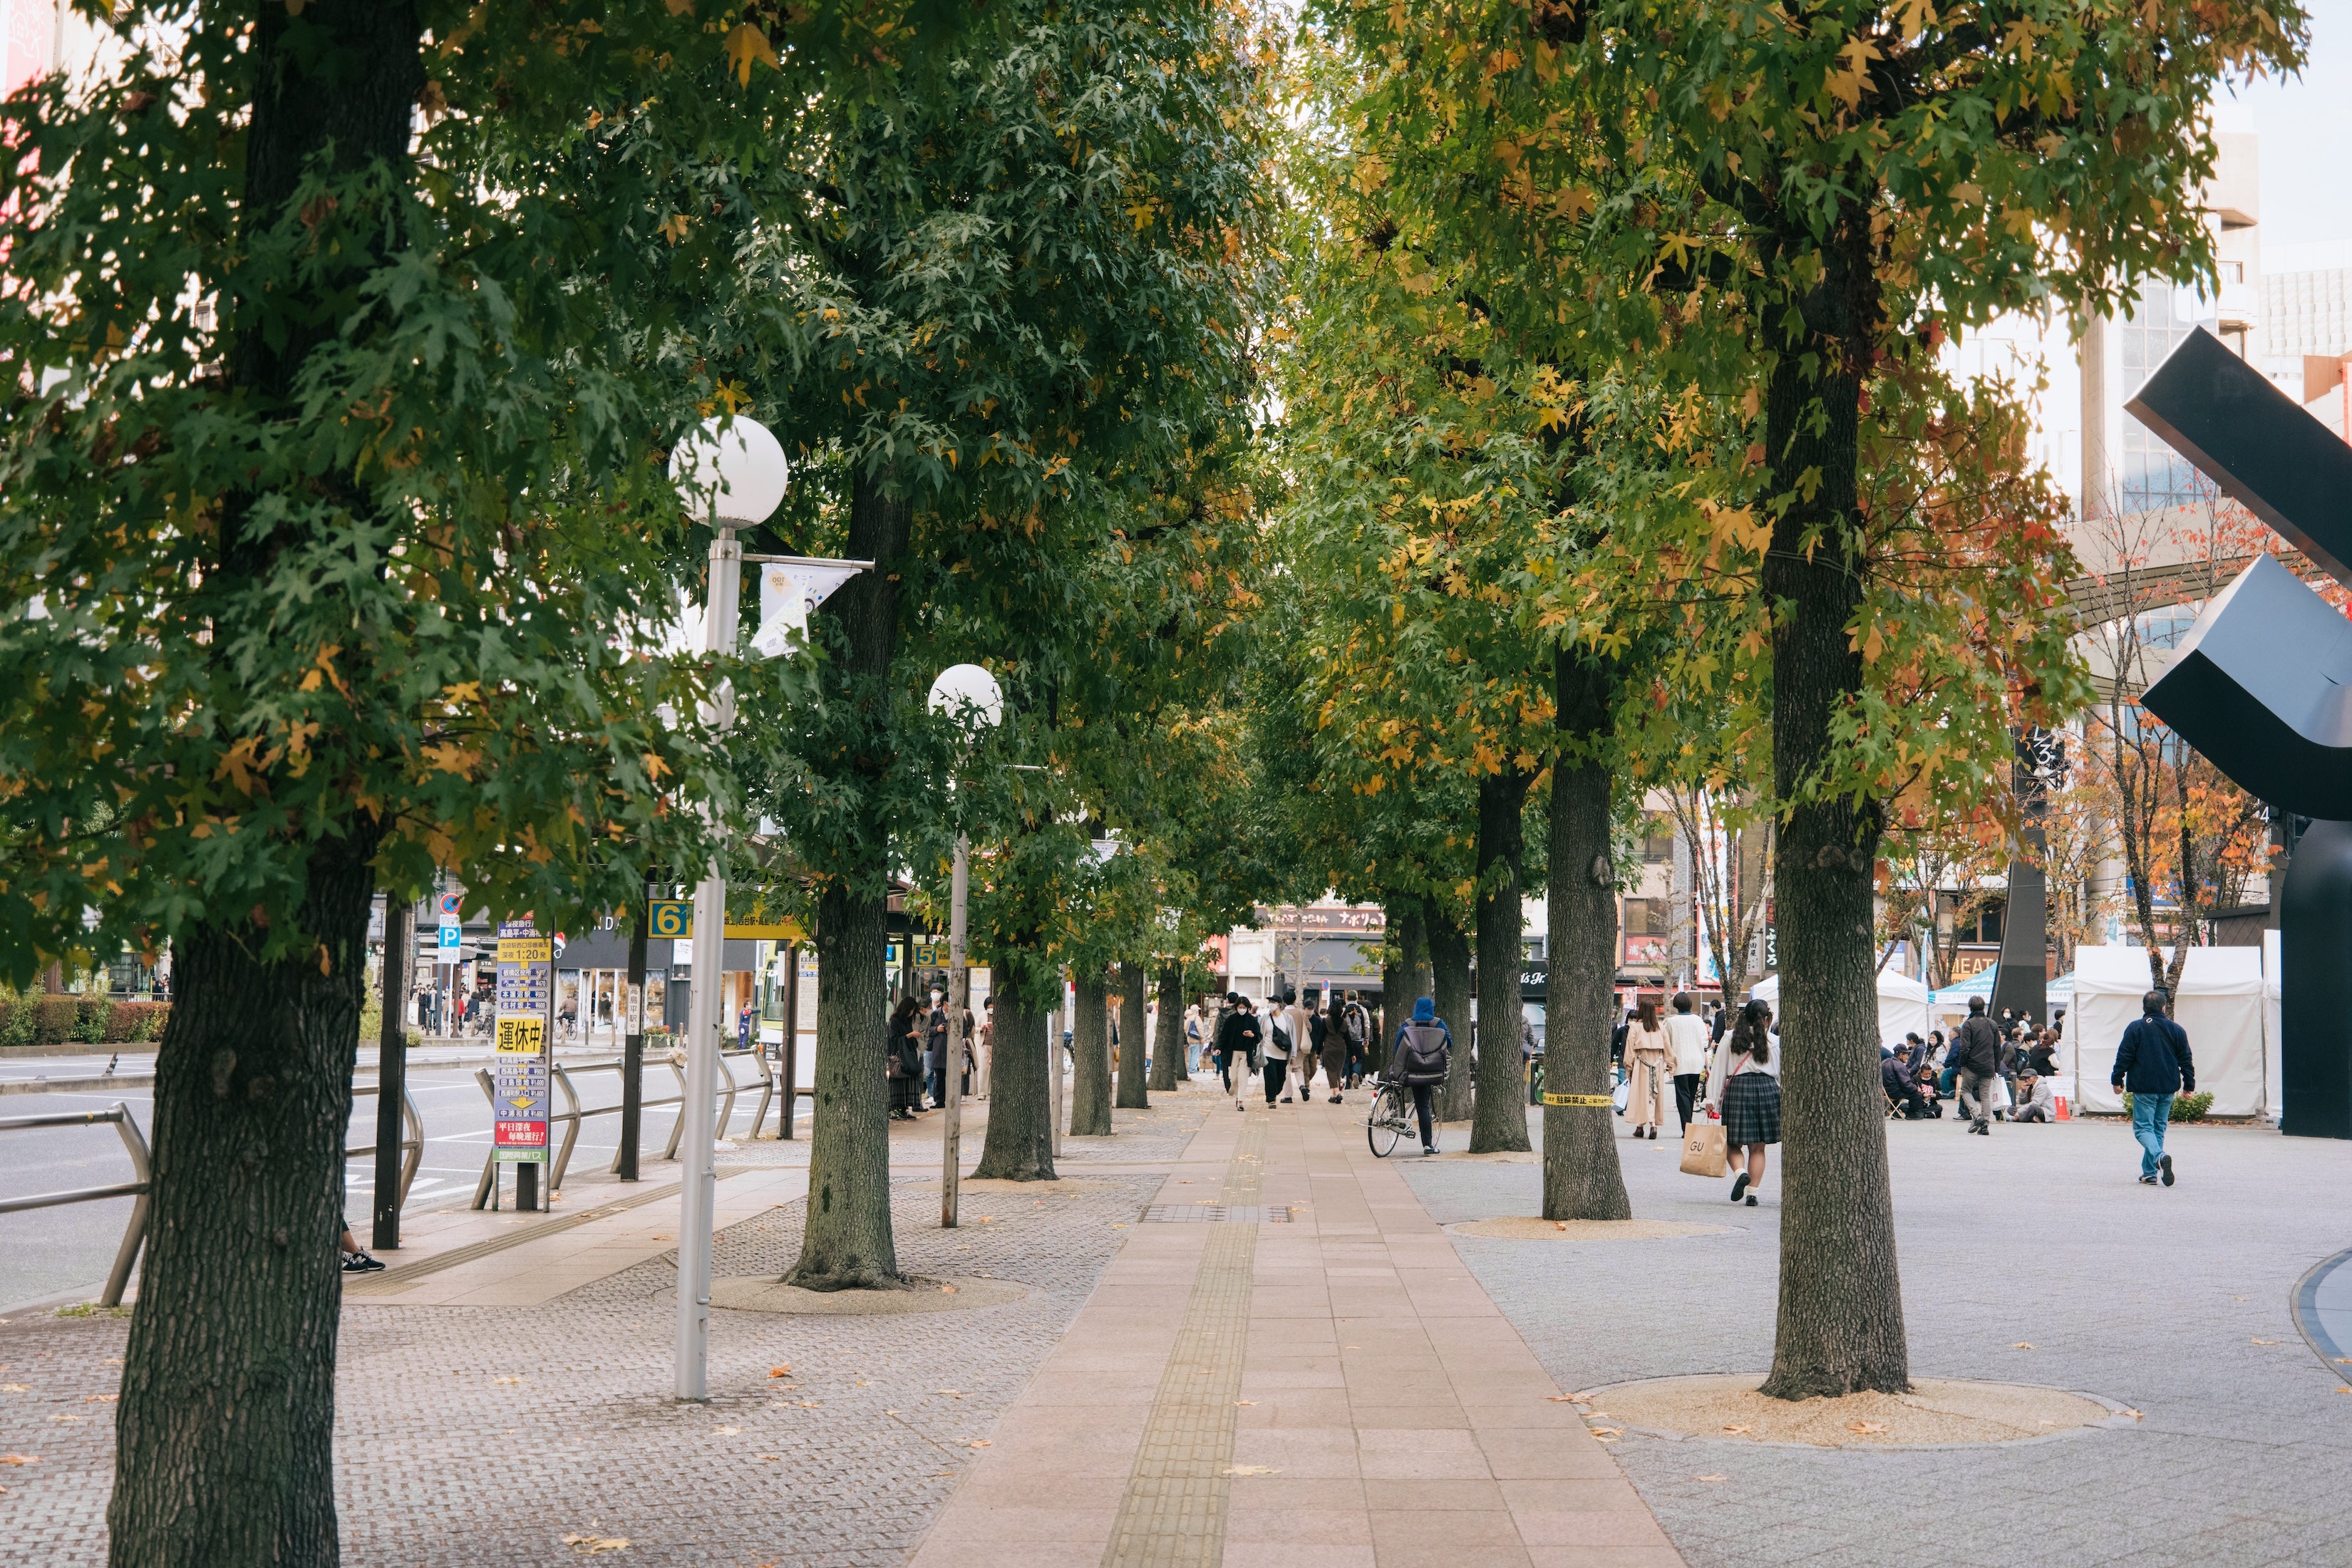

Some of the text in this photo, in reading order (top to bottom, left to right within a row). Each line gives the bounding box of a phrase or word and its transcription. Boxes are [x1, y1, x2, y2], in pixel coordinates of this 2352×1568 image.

[656, 905, 681, 934] 6
[444, 929, 457, 946] P
[517, 950, 538, 959] 1:20
[919, 948, 933, 965] 5
[499, 1021, 540, 1051] 運休中
[499, 1123, 531, 1132] 平日深夜
[1690, 1141, 1704, 1152] GU
